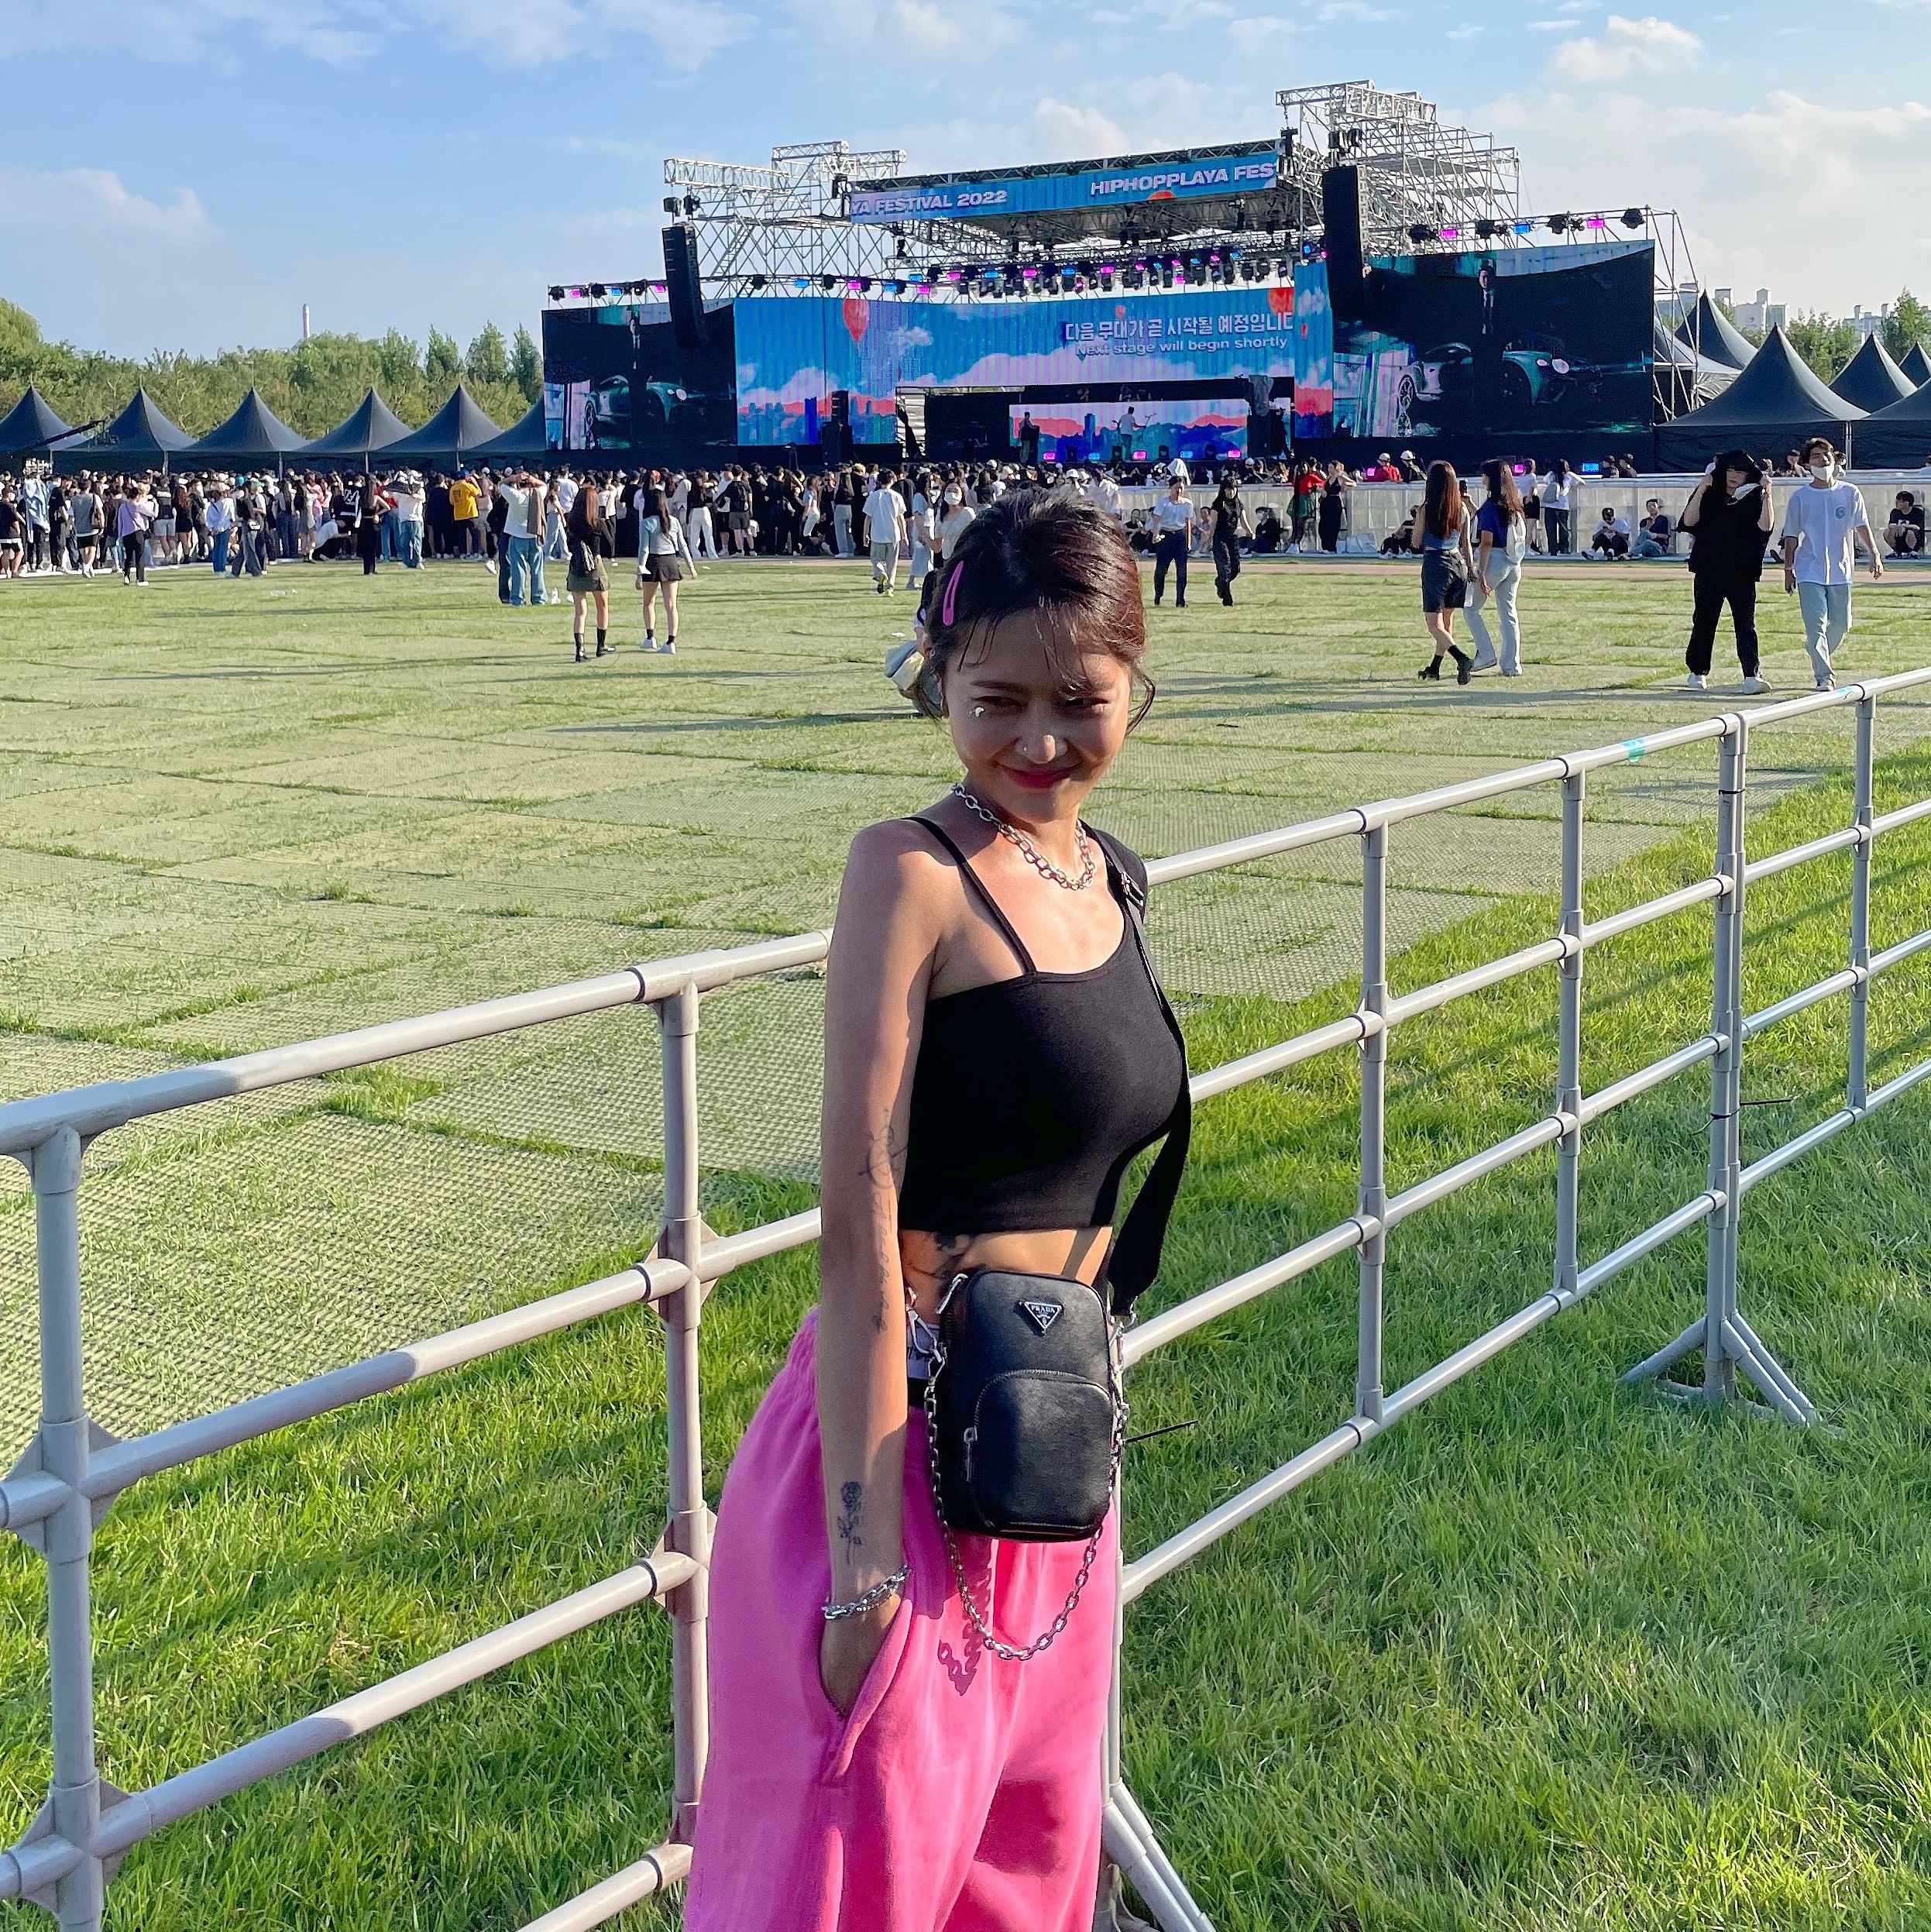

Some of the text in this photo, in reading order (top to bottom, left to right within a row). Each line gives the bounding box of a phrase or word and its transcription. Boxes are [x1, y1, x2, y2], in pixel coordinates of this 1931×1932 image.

[1091, 163, 1276, 194] HIPHOPPLAYA FES
[875, 194, 953, 212] FESTIVAL
[957, 191, 1007, 207] 2022
[1065, 322, 1094, 341] 다음
[1099, 320, 1143, 339] 무대가
[1167, 317, 1213, 335] 시작될
[1076, 335, 1287, 356] Next stage will begin shortly
